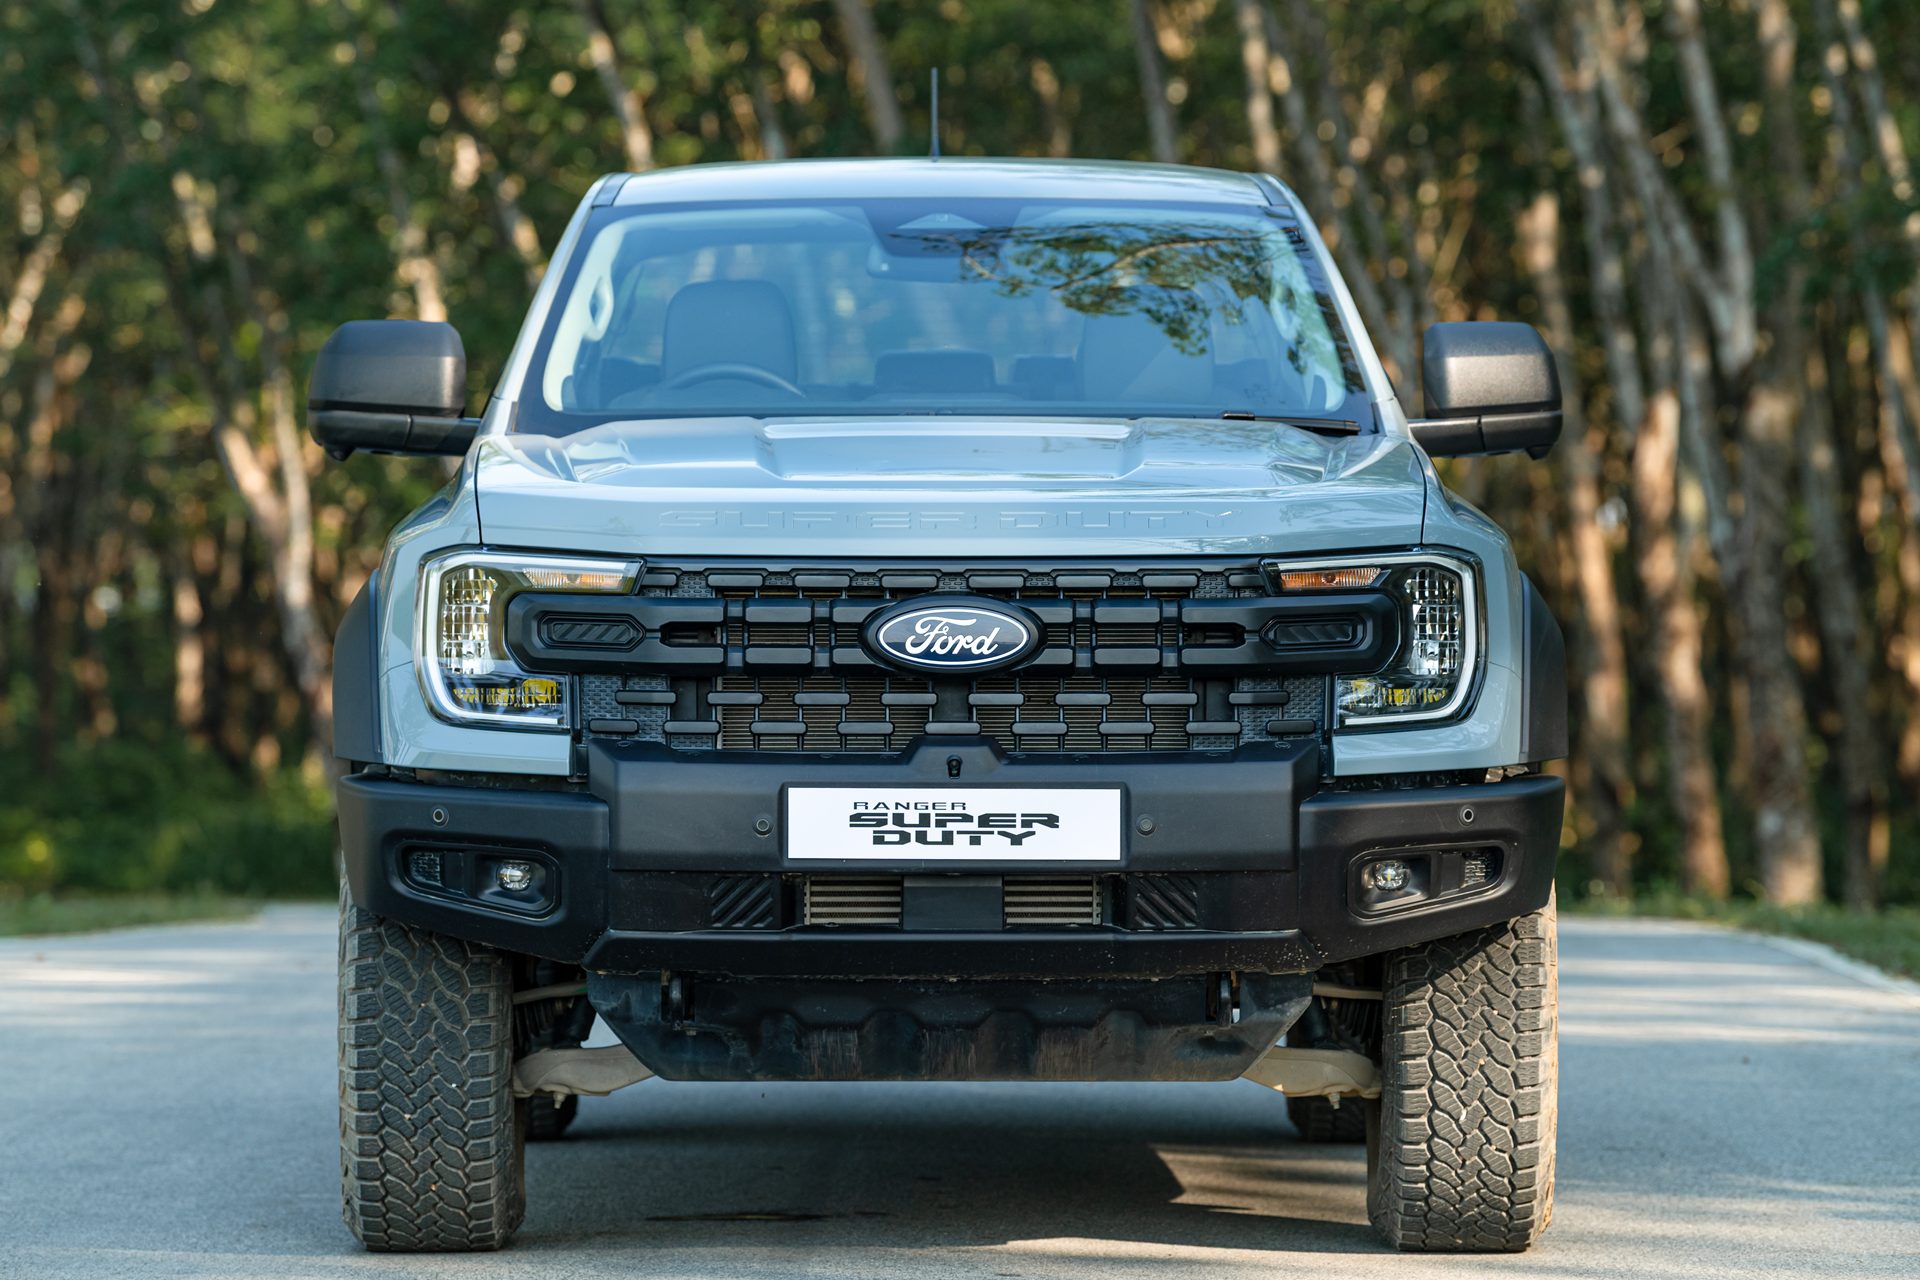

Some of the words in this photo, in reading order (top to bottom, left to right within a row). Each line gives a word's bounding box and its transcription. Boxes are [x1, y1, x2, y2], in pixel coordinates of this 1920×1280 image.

[658, 510, 978, 530] SUPER
[999, 510, 1243, 529] DUTY
[905, 616, 1001, 655] Ford
[853, 801, 967, 811] RANGER
[849, 812, 1060, 829] SUPER
[872, 829, 1037, 846] DUTY
